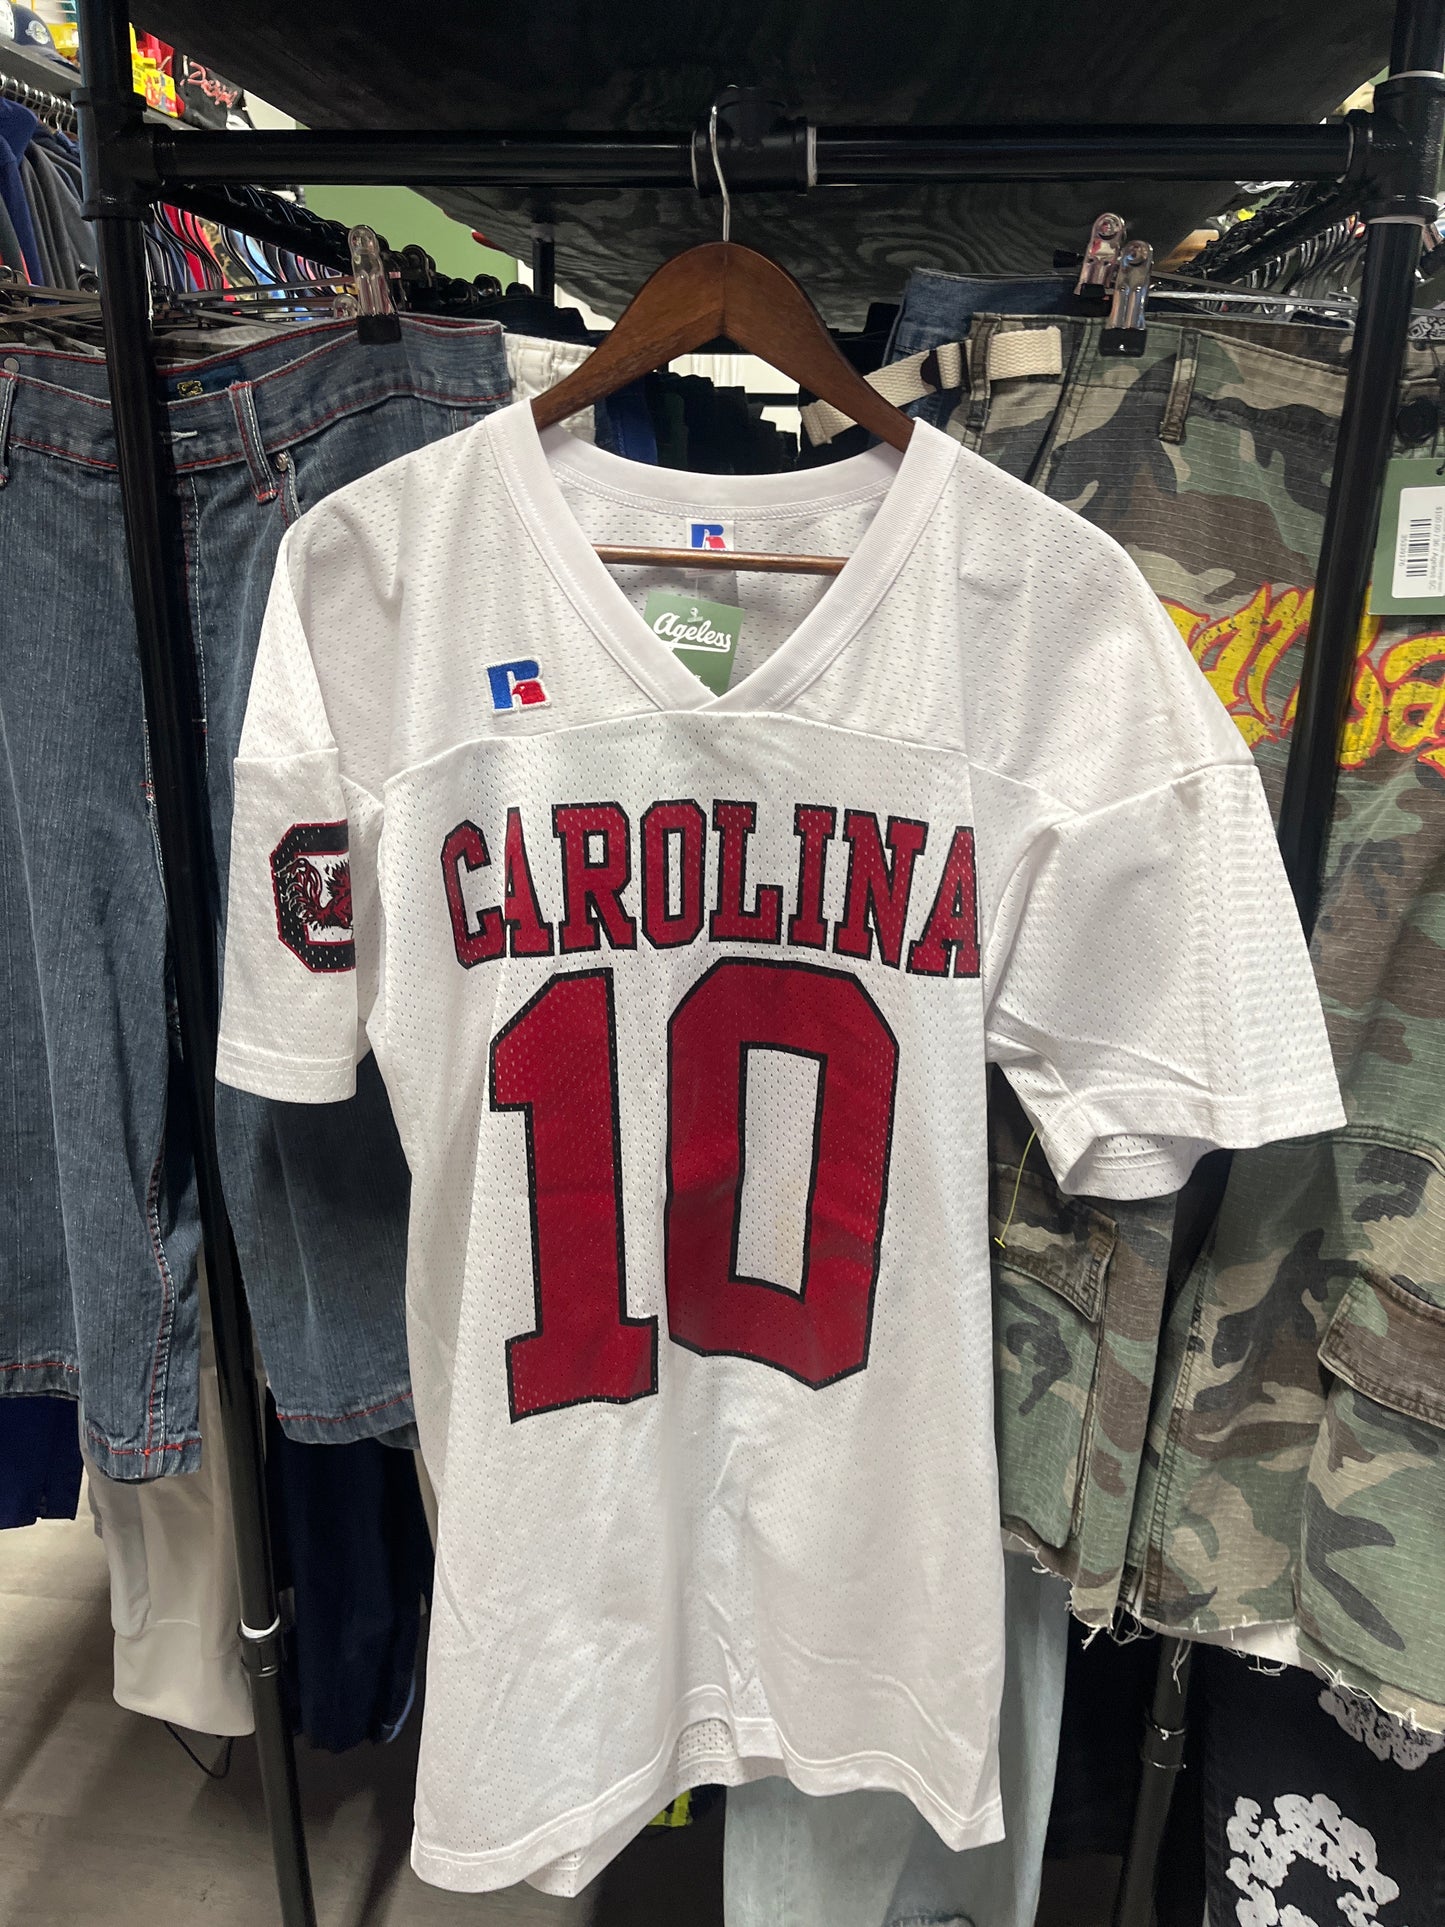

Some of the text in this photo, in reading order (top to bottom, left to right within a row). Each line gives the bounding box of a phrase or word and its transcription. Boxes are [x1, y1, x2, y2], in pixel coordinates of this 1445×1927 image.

[653, 612, 731, 652] Ageless
[440, 798, 982, 979] CAROLINA
[488, 955, 901, 1425] 10
